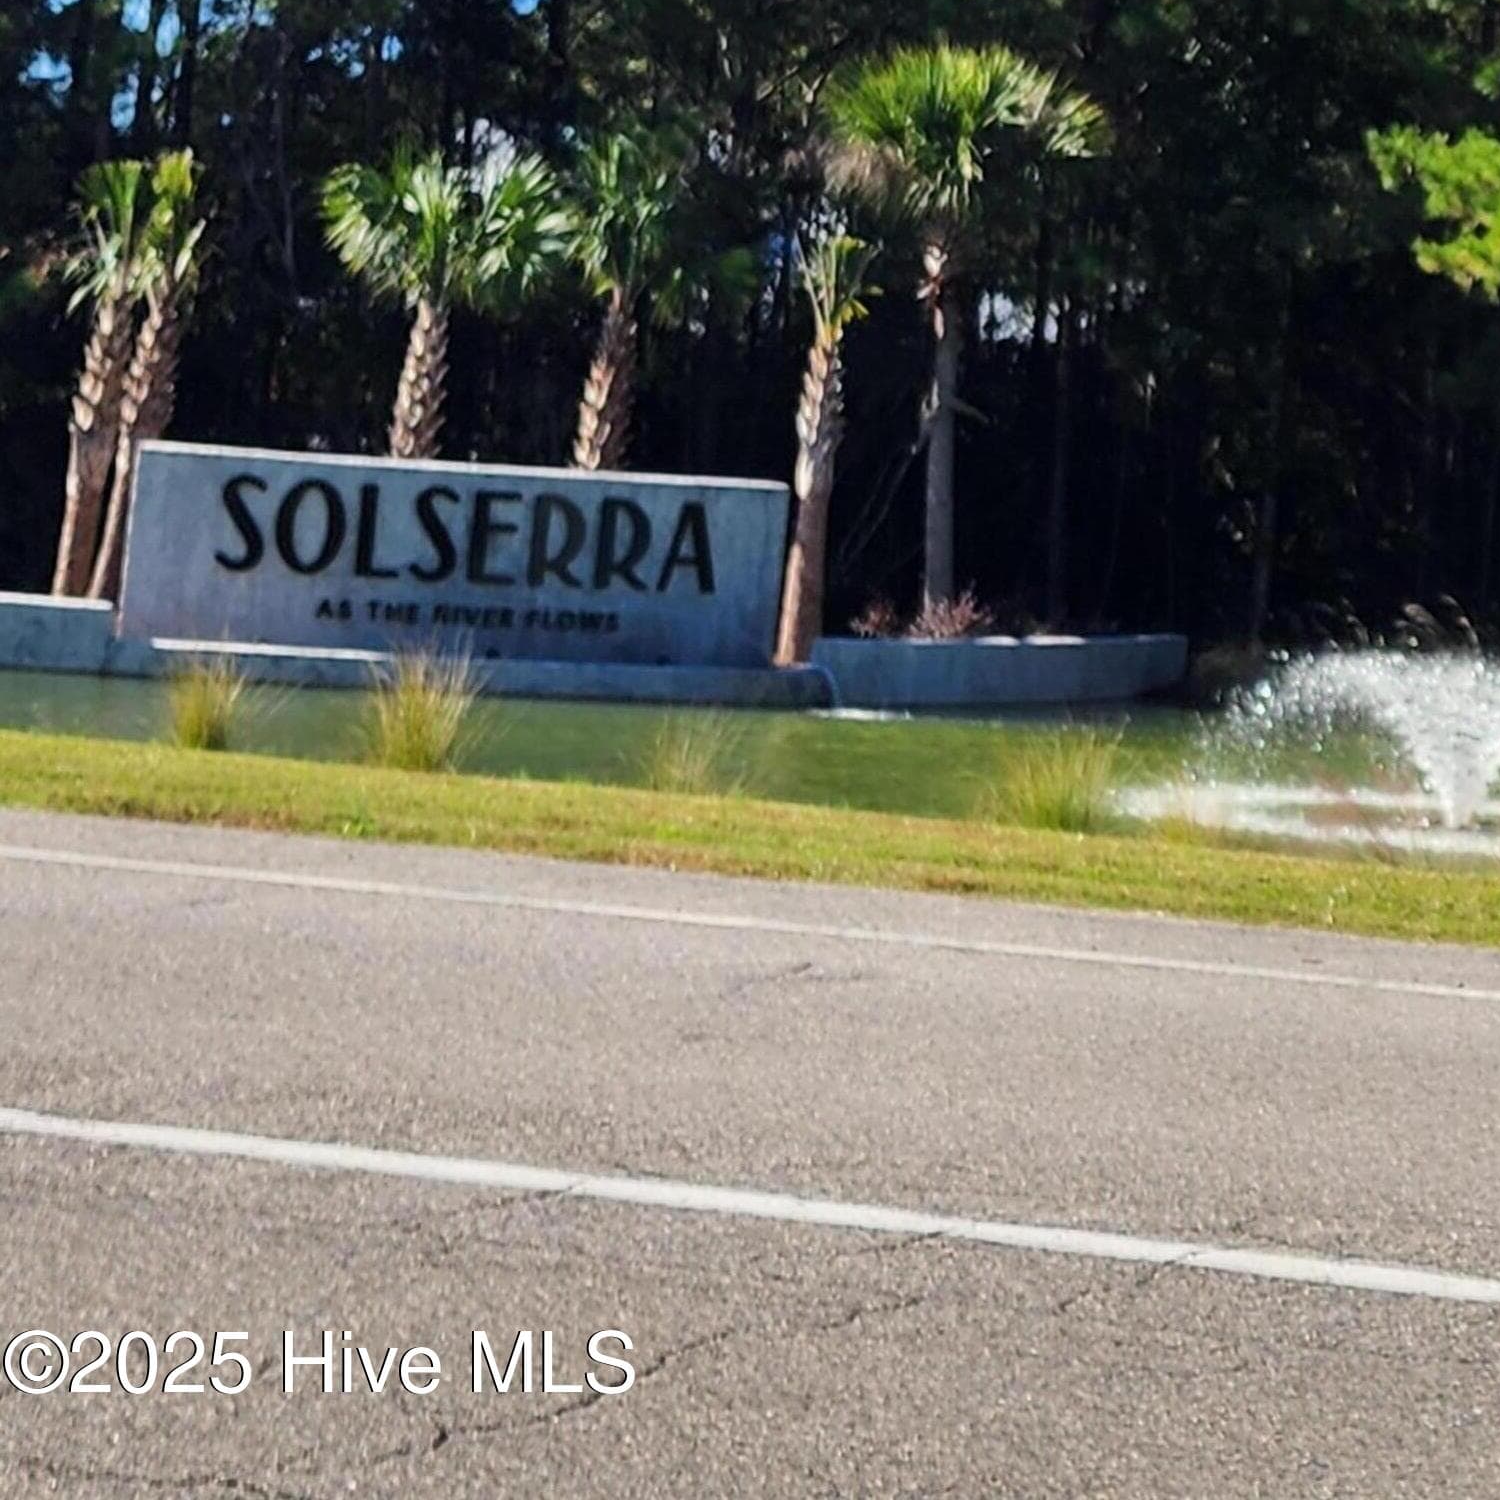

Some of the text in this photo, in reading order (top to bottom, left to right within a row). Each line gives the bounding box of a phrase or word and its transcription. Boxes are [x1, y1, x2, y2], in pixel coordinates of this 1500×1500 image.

[214, 473, 717, 595] SOLSERRA
[315, 598, 620, 633] AS THE RIVER FLOWS
